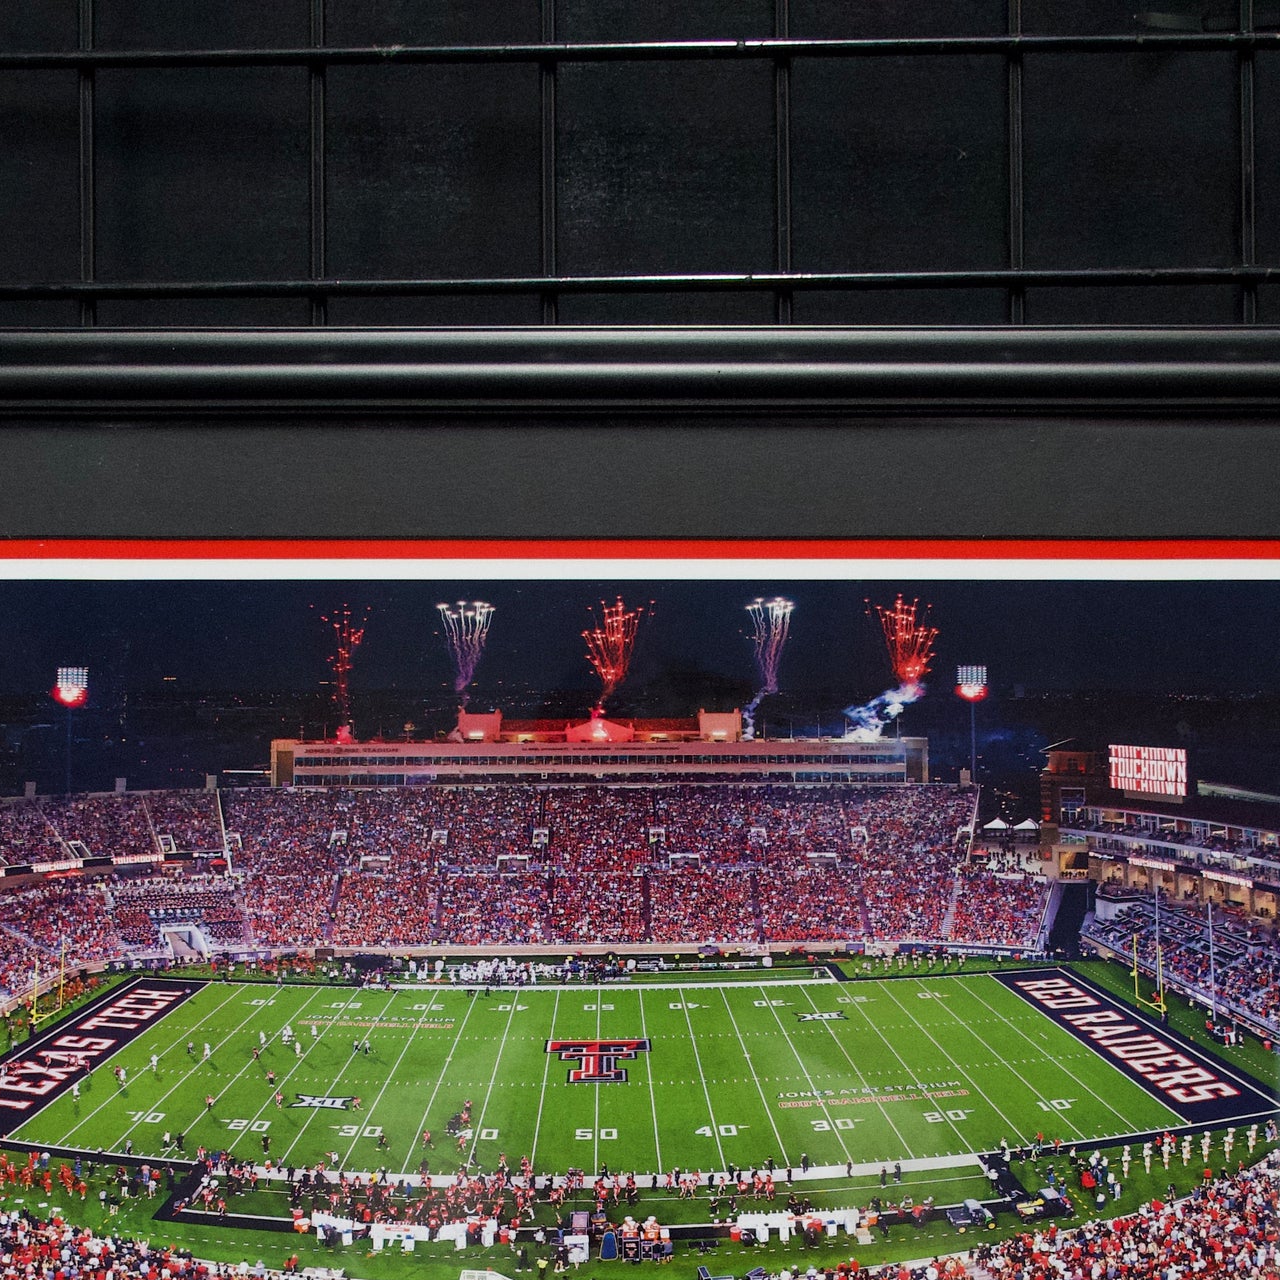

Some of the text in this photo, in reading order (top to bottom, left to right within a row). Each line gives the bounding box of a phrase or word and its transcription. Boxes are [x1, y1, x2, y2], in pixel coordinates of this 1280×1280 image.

[1109, 757, 1186, 783] TOUCHDOWN
[111, 853, 164, 865] TOUCHDOWN
[31, 860, 83, 874] TOUCHDOWN
[76, 988, 186, 1031] TECH
[1014, 978, 1241, 1103] RED RAIDERS
[778, 1089, 835, 1099] JONES
[883, 1080, 961, 1092] STADIUM
[1036, 1099, 1072, 1112] 10
[132, 1112, 166, 1123] 10
[922, 1109, 967, 1123] 20
[228, 1119, 271, 1132] 20
[338, 1125, 383, 1138] 30
[695, 1124, 738, 1137] 40
[810, 1118, 855, 1132] 30
[575, 1128, 618, 1140] 50
